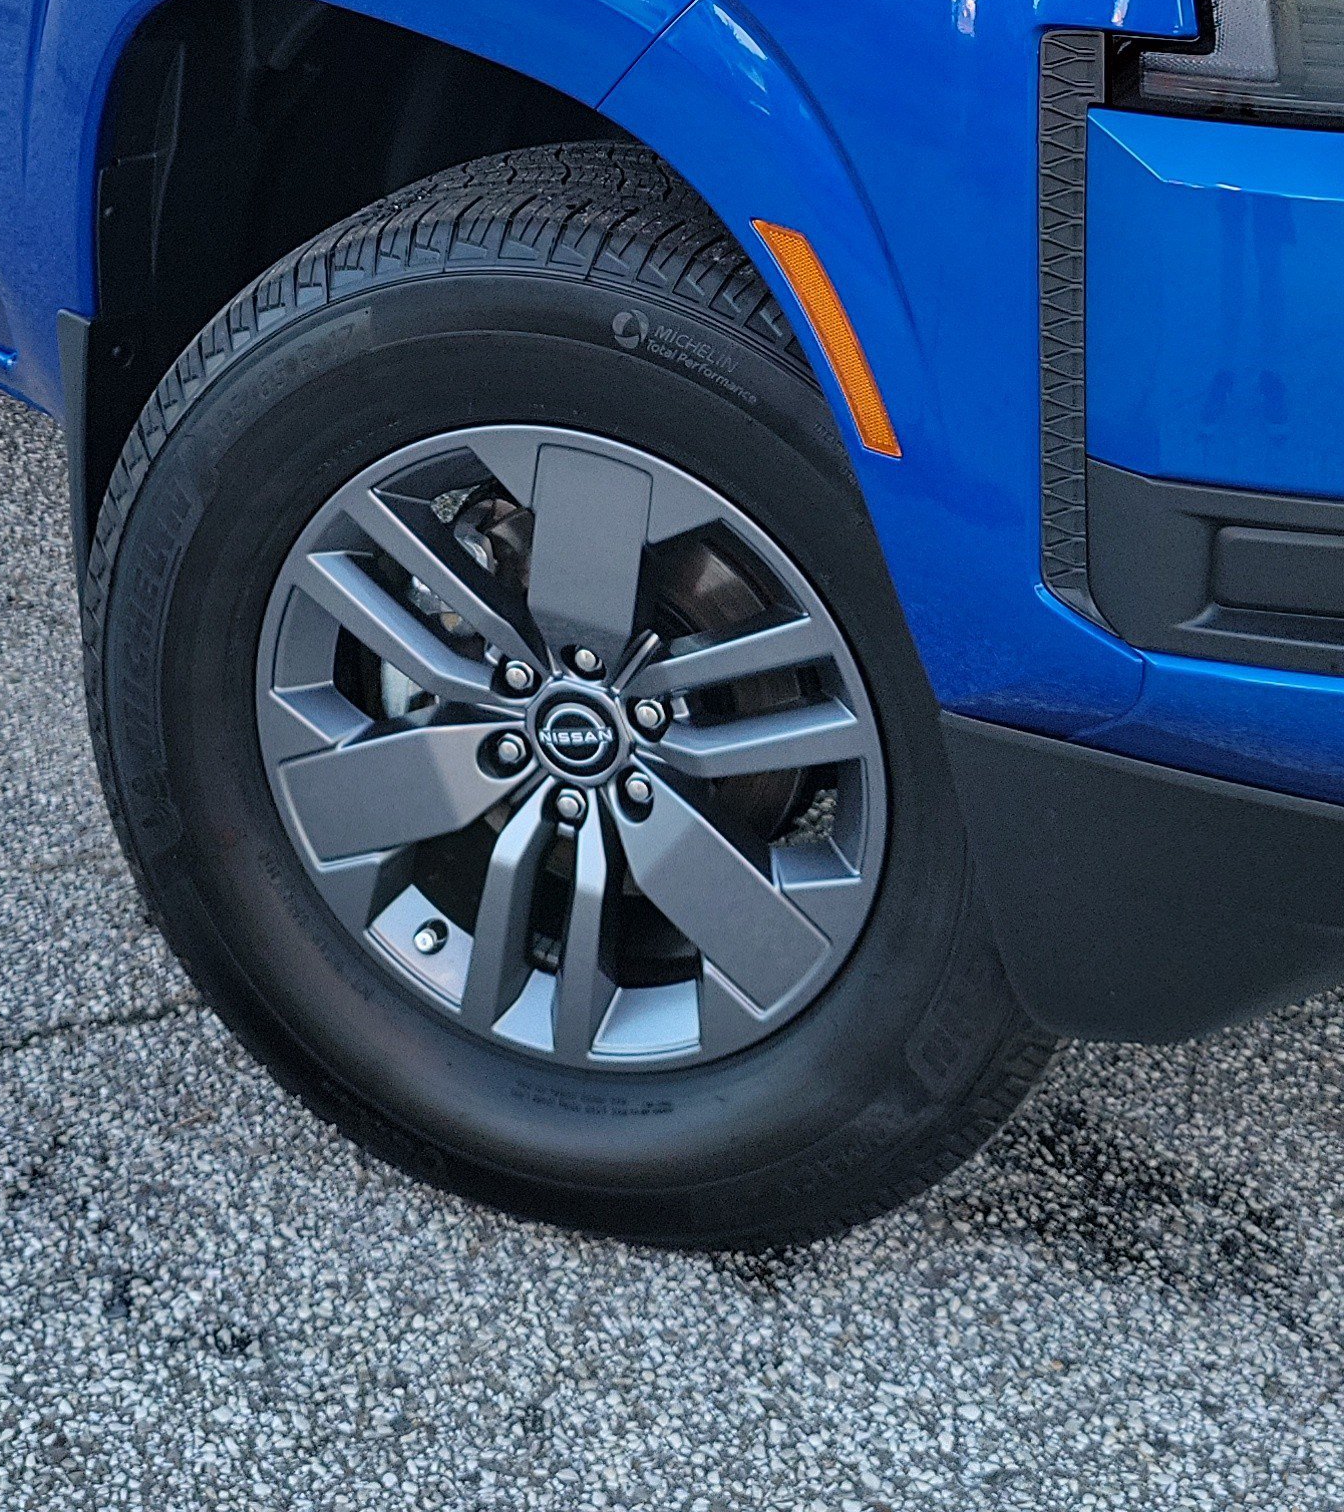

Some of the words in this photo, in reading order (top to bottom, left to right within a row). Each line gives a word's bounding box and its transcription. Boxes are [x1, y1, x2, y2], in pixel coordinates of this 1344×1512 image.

[646, 338, 677, 361] Total
[678, 352, 758, 405] Performance
[655, 324, 740, 374] MICHELIN
[539, 729, 614, 746] NISSAN
